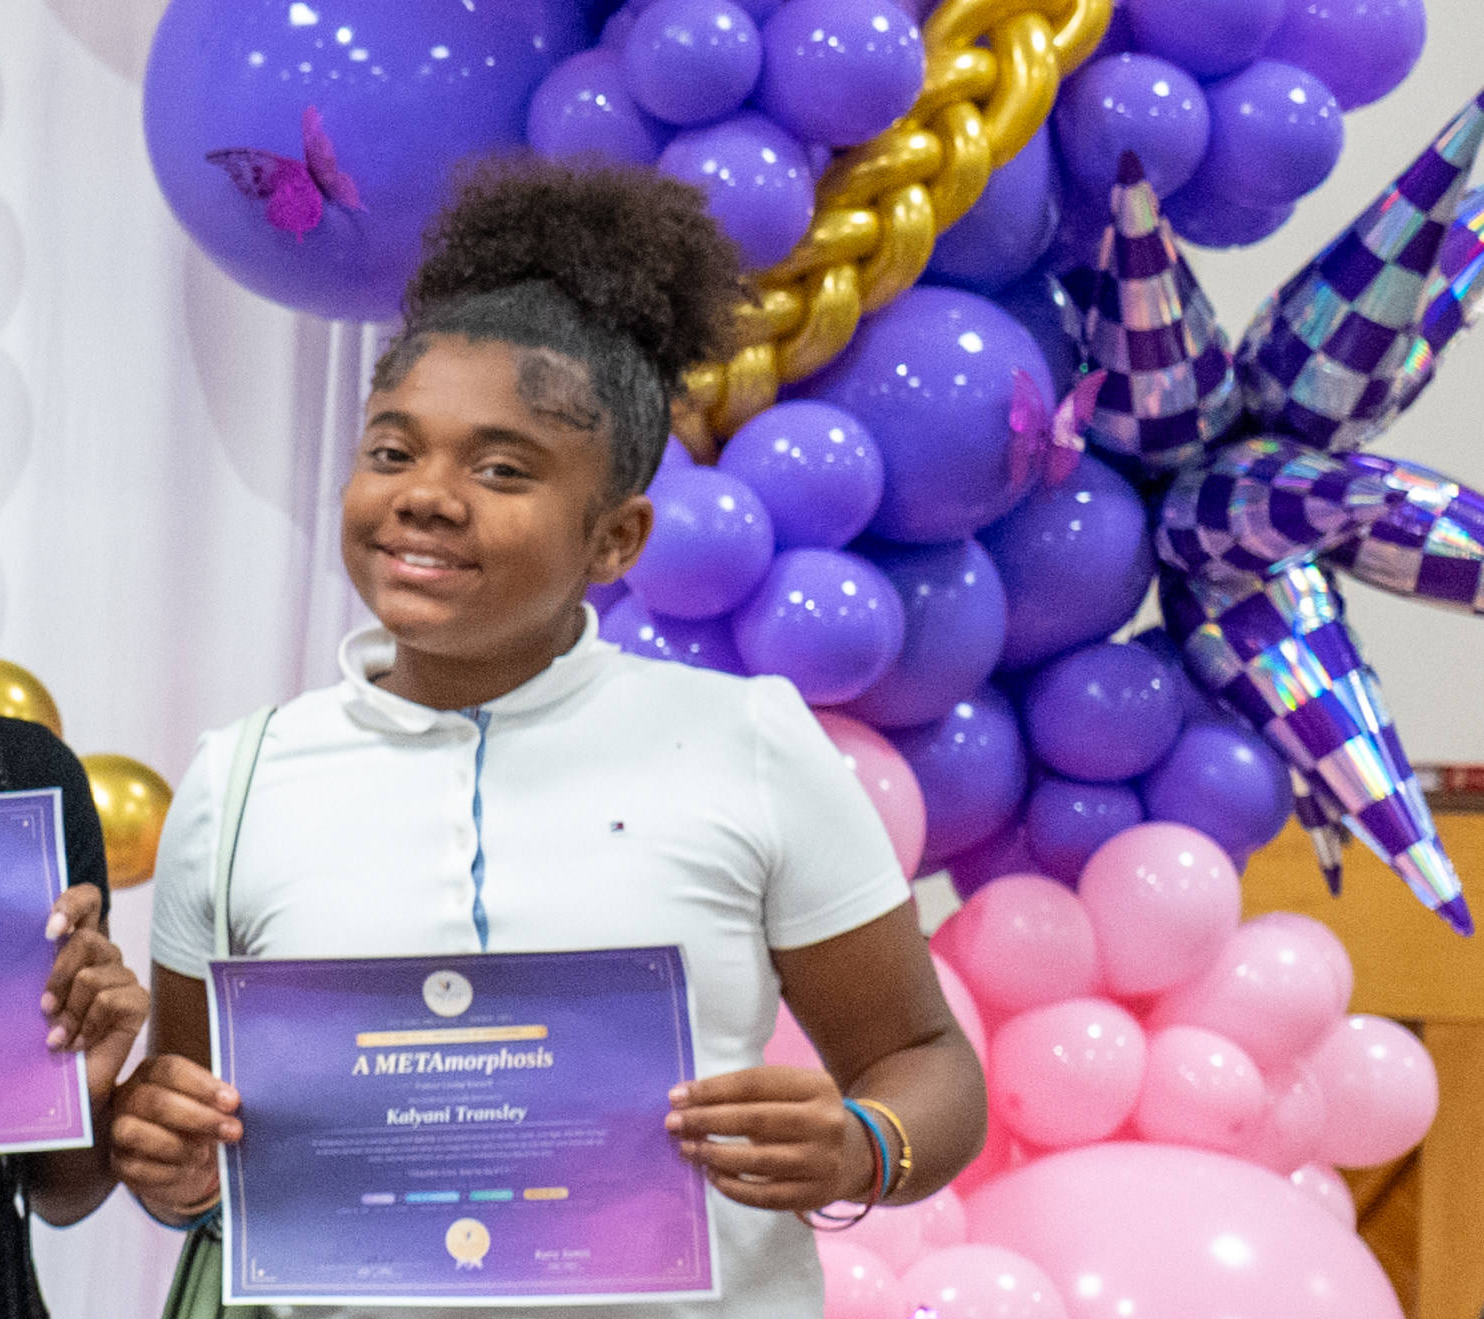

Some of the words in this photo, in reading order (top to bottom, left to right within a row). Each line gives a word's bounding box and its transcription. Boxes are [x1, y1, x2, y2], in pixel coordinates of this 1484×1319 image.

[352, 1055, 370, 1076] A
[375, 1047, 554, 1075] METAmorphosis
[386, 1105, 451, 1128] Kalyani
